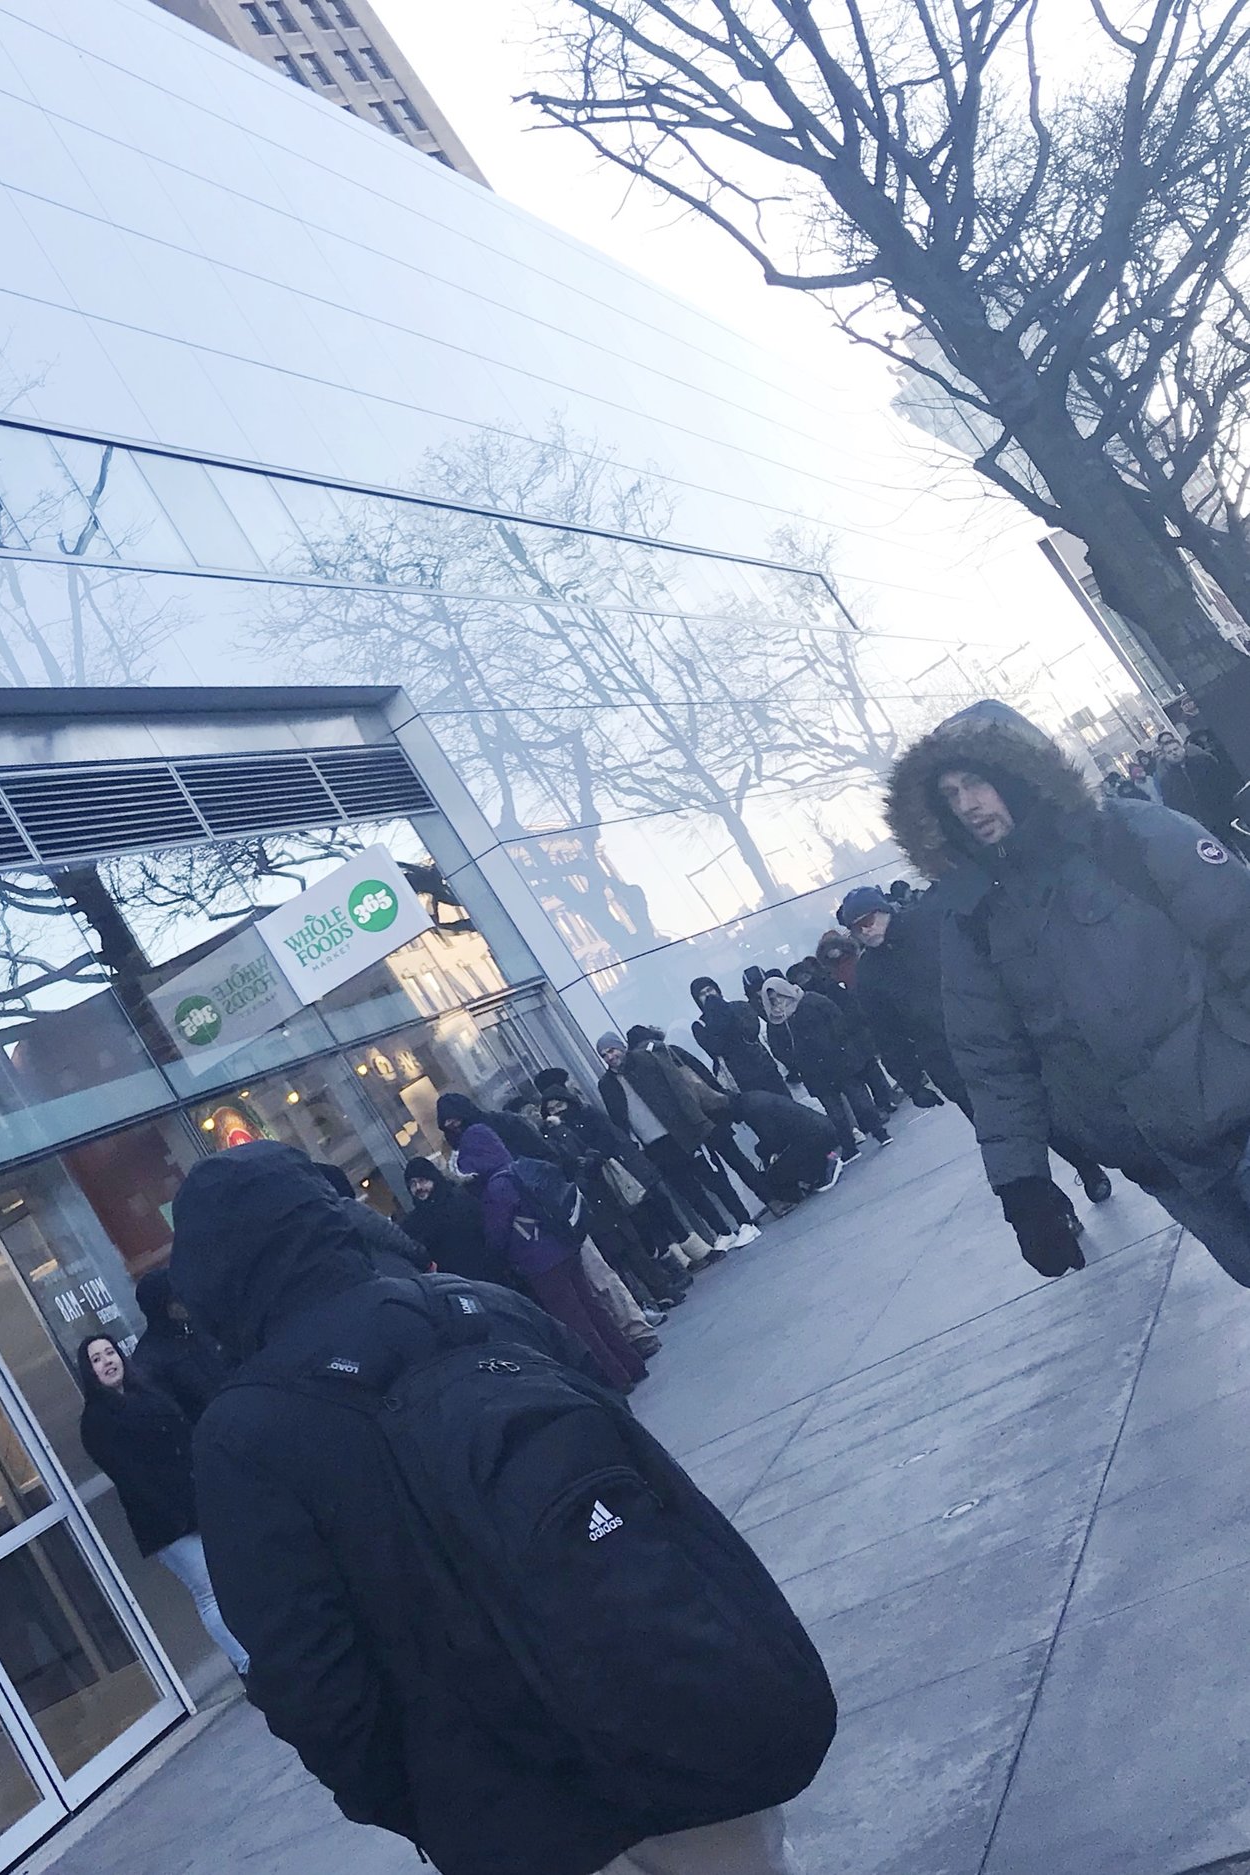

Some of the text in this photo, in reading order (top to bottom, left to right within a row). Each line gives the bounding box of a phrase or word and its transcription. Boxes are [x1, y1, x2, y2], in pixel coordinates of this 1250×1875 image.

[353, 889, 394, 925] 365
[283, 905, 347, 953] WHOLE
[296, 923, 354, 968] FOODS
[312, 943, 351, 973] MARKET
[330, 1362, 359, 1374] LOAD
[589, 1516, 624, 1542] adidas
